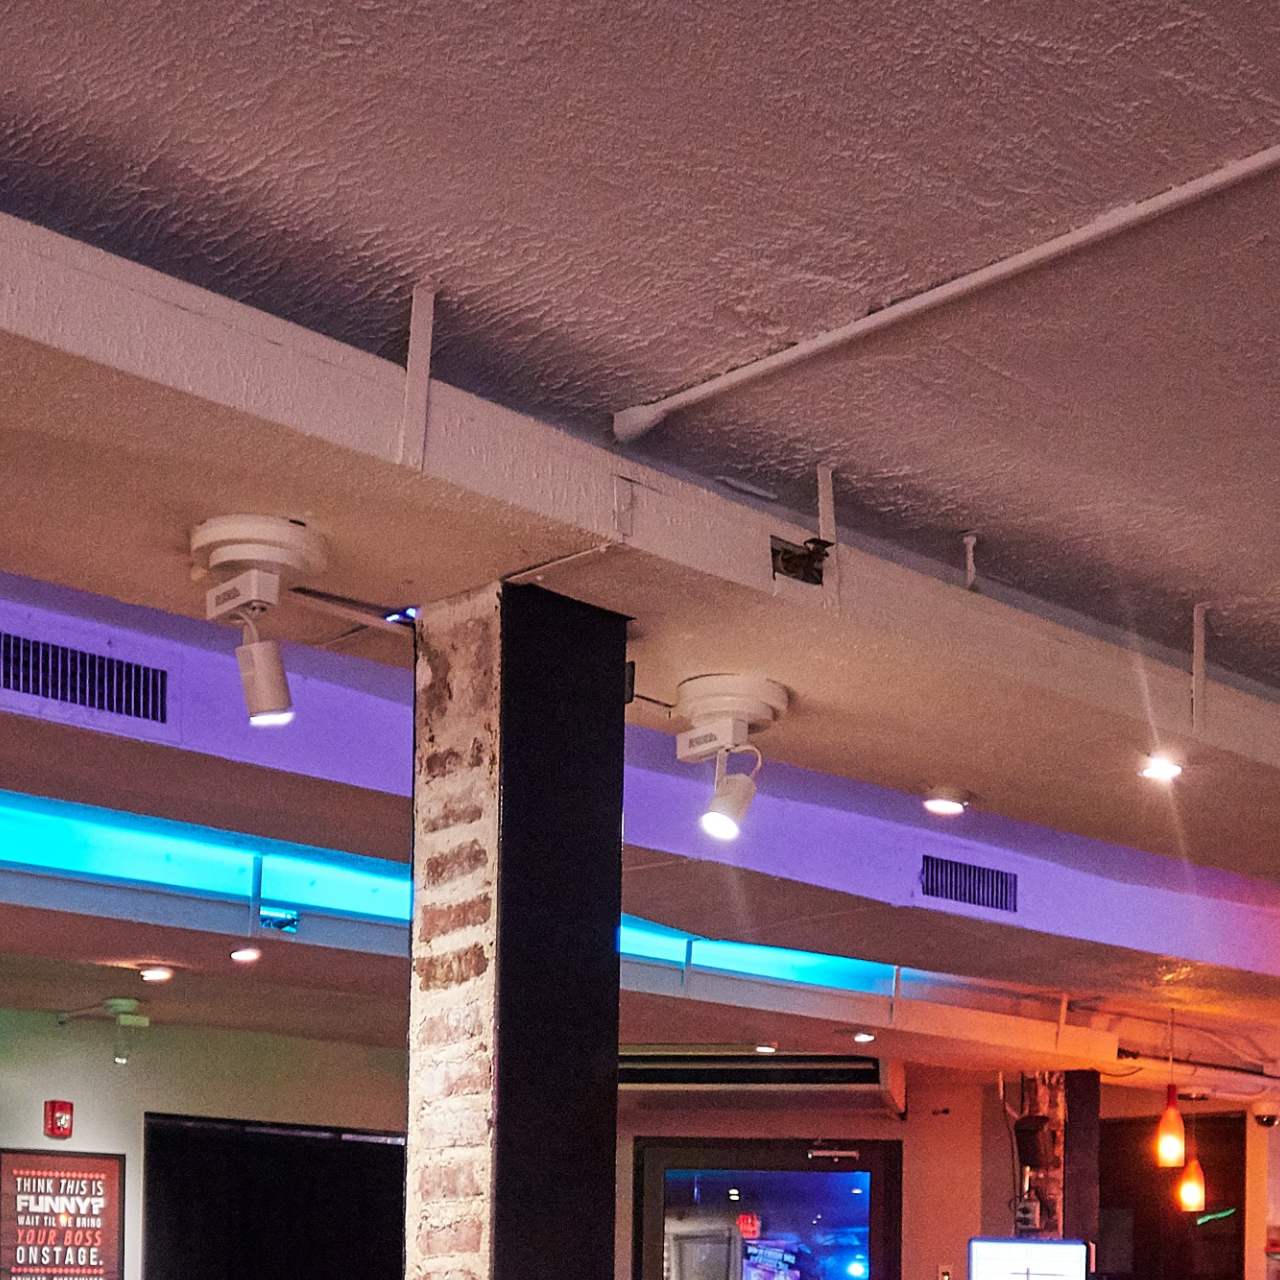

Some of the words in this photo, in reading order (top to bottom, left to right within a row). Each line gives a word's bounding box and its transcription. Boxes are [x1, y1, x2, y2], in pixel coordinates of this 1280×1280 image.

[16, 1178, 54, 1194] THINK
[59, 1179, 87, 1195] THIS
[92, 1180, 104, 1196] IS
[16, 1195, 106, 1214] FUNNY?
[17, 1215, 40, 1226] WAIT
[44, 1216, 56, 1227] TIL
[60, 1216, 72, 1228] WE
[76, 1216, 102, 1228] BRING
[16, 1230, 56, 1245] YOUR
[63, 1230, 102, 1247] BOSS
[16, 1246, 104, 1266] ONSTAGE.
